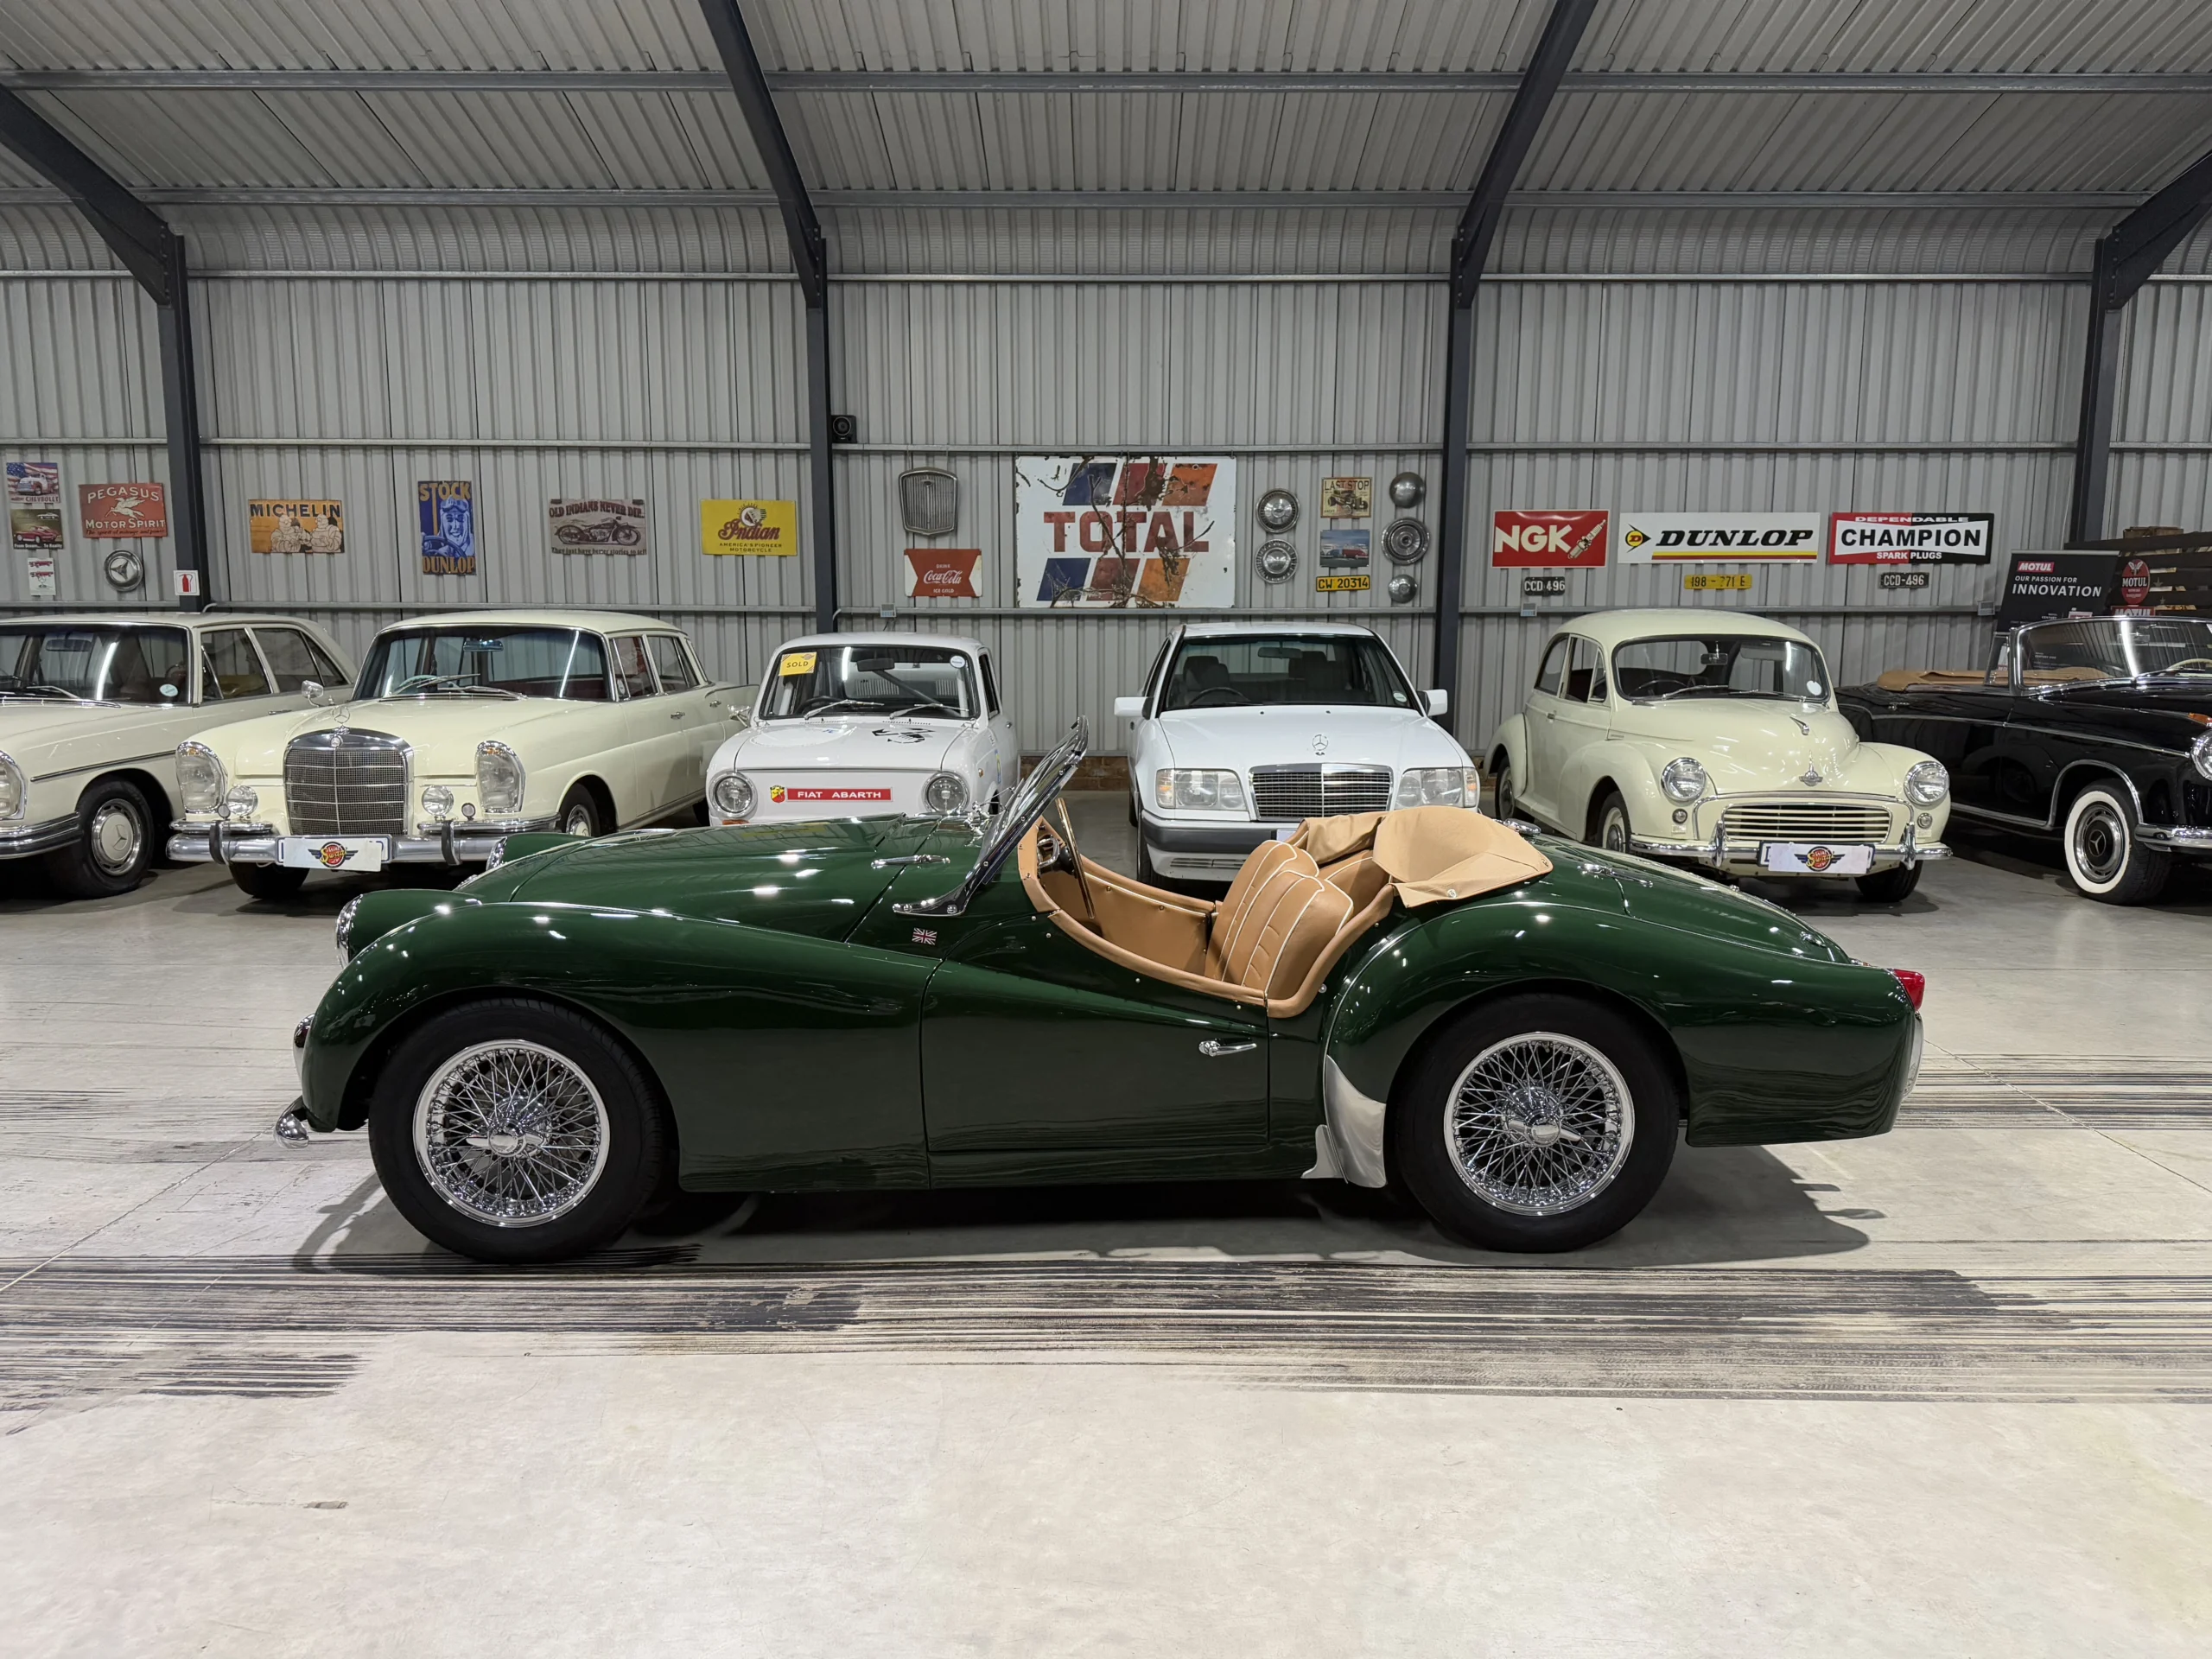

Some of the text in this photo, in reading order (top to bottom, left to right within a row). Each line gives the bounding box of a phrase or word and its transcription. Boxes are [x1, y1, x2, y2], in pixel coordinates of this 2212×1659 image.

[1324, 480, 1370, 491] LAST STOP
[87, 486, 160, 504] PEGASUS
[250, 504, 340, 518] MICHELIN
[550, 506, 565, 518] OLD
[566, 501, 599, 516] INDIANS
[600, 501, 626, 516] NEVER
[86, 518, 165, 529] MOTOR SPIRIT
[718, 518, 780, 541] Indian
[1044, 511, 1210, 553] TOTAL
[1494, 524, 1573, 553] NGK
[1655, 530, 1814, 546] DUNLOP
[1841, 529, 1981, 547] CHAMPION
[423, 556, 475, 574] DUNLOP
[2018, 563, 2052, 571] MOTUL
[1318, 577, 1369, 588] CW 20314
[1524, 580, 1566, 592] CCD 496
[1884, 575, 1924, 586] CCD-496
[2122, 577, 2147, 587] MOTUL
[2012, 584, 2101, 597] INNOVATION
